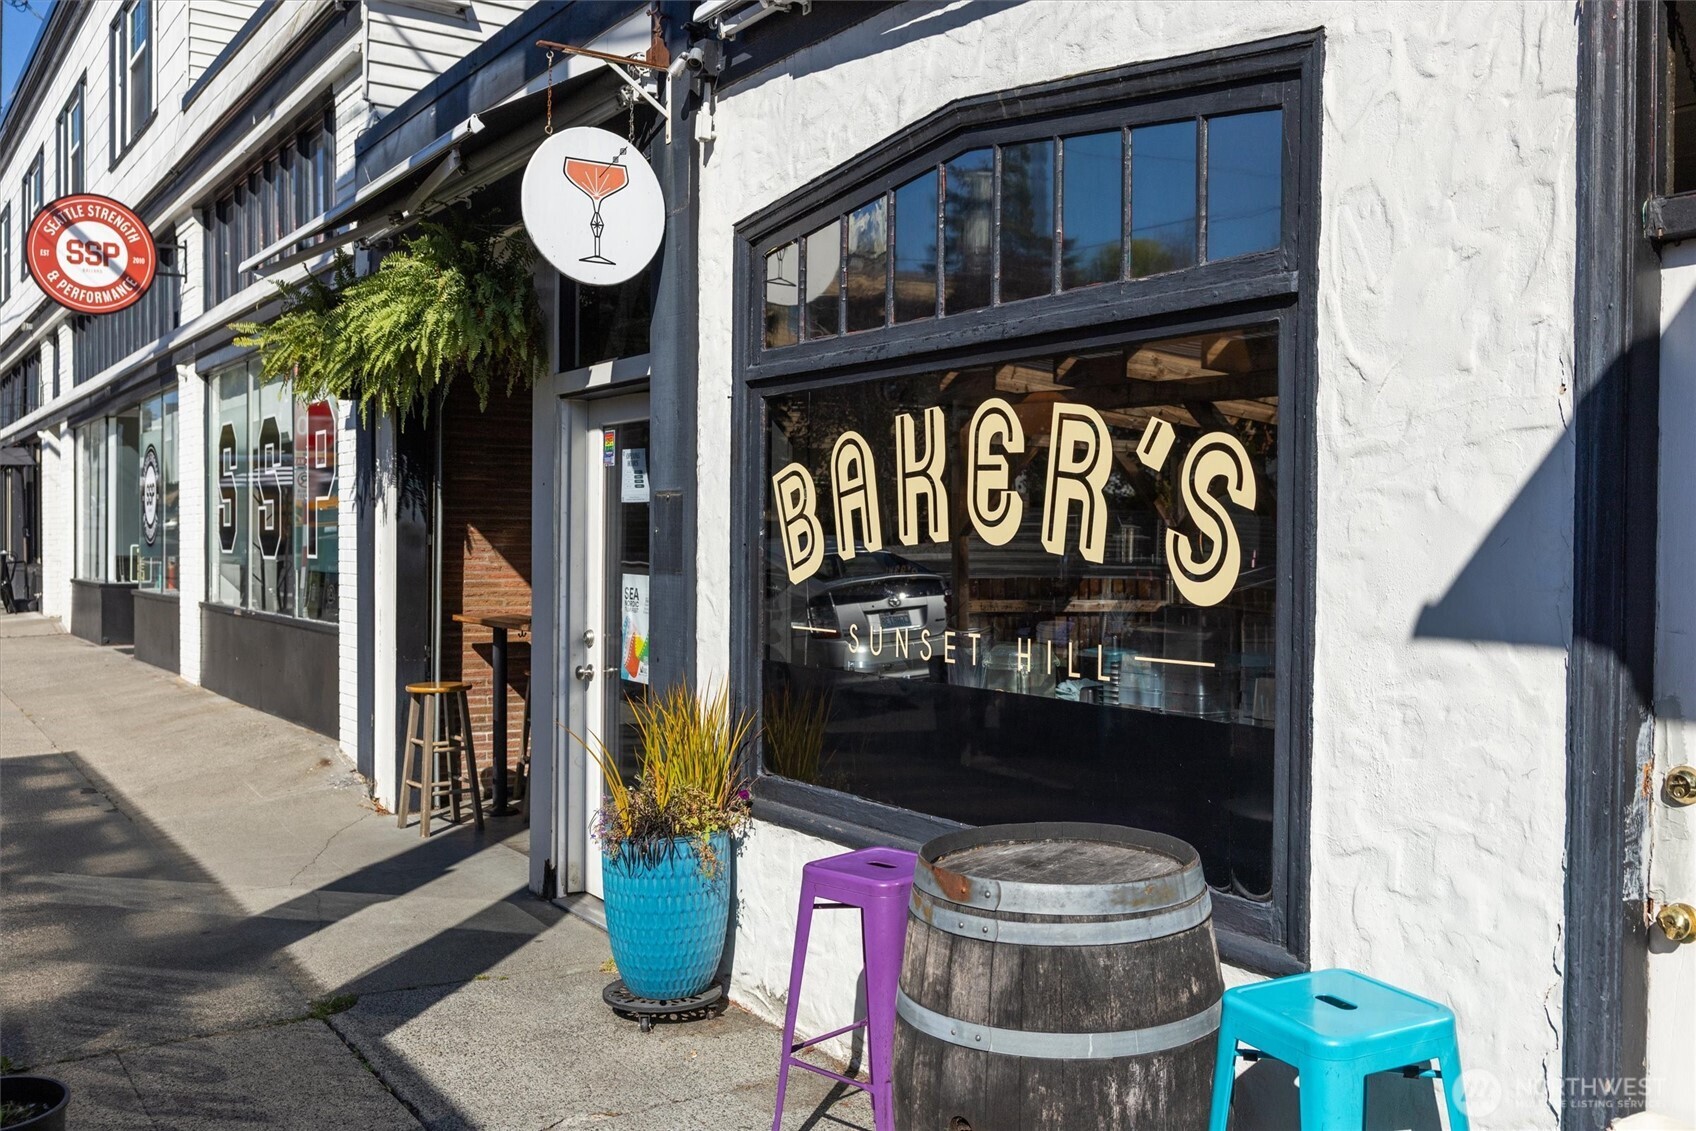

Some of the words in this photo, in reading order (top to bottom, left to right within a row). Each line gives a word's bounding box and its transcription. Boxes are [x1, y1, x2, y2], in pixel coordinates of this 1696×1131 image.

[43, 204, 85, 236] SEATTLE
[87, 204, 141, 244] STRENGTH
[66, 239, 120, 267] SSP
[47, 270, 59, 283] &
[56, 276, 138, 304] PERFORMANCE
[218, 398, 337, 560] SSP
[772, 397, 1257, 608] BAKER'S
[624, 586, 640, 601] SEA
[848, 623, 981, 666] SUNSET
[1017, 637, 1112, 682] HILL
